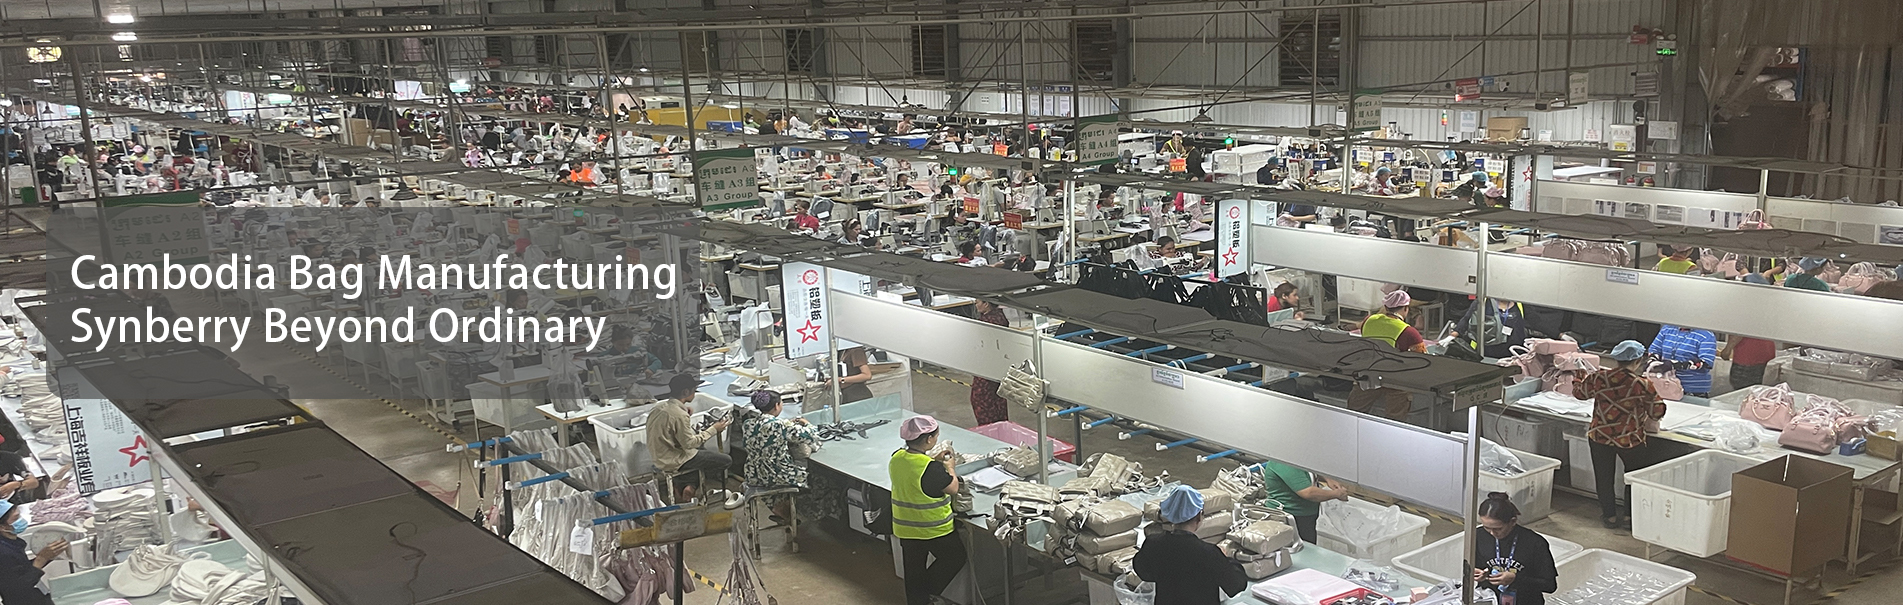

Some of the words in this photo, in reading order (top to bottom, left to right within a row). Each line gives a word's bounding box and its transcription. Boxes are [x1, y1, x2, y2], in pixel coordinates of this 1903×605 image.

[742, 164, 755, 173] A3
[701, 176, 756, 192] 车缝A3组
[706, 194, 719, 202] A3
[724, 191, 753, 201] Group
[180, 211, 200, 221] A2
[115, 227, 203, 247] 车缝A2组
[123, 250, 144, 261] A2
[152, 246, 199, 258] Group
[808, 286, 822, 321] 铝塑板
